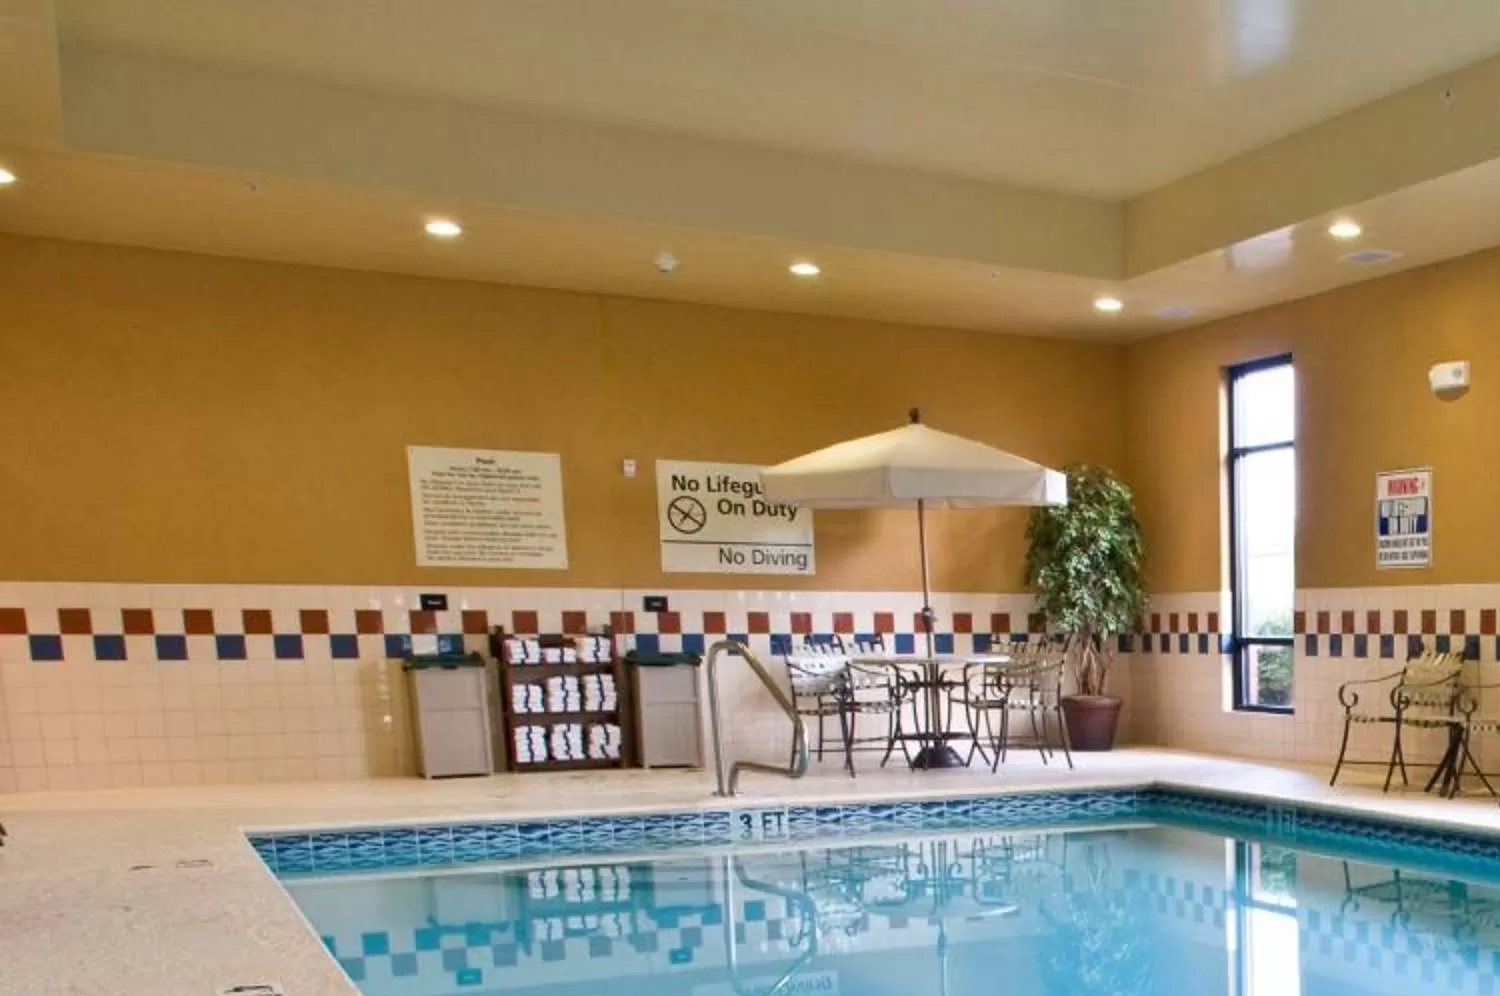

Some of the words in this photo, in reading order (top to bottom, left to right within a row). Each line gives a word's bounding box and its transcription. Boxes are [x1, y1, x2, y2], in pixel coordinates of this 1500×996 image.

[671, 475, 700, 492] No
[706, 475, 763, 498] Lifegu
[717, 499, 745, 516] On
[753, 499, 797, 521] Duty
[719, 548, 745, 565] No
[752, 549, 808, 570] Diving
[762, 812, 785, 832] FT
